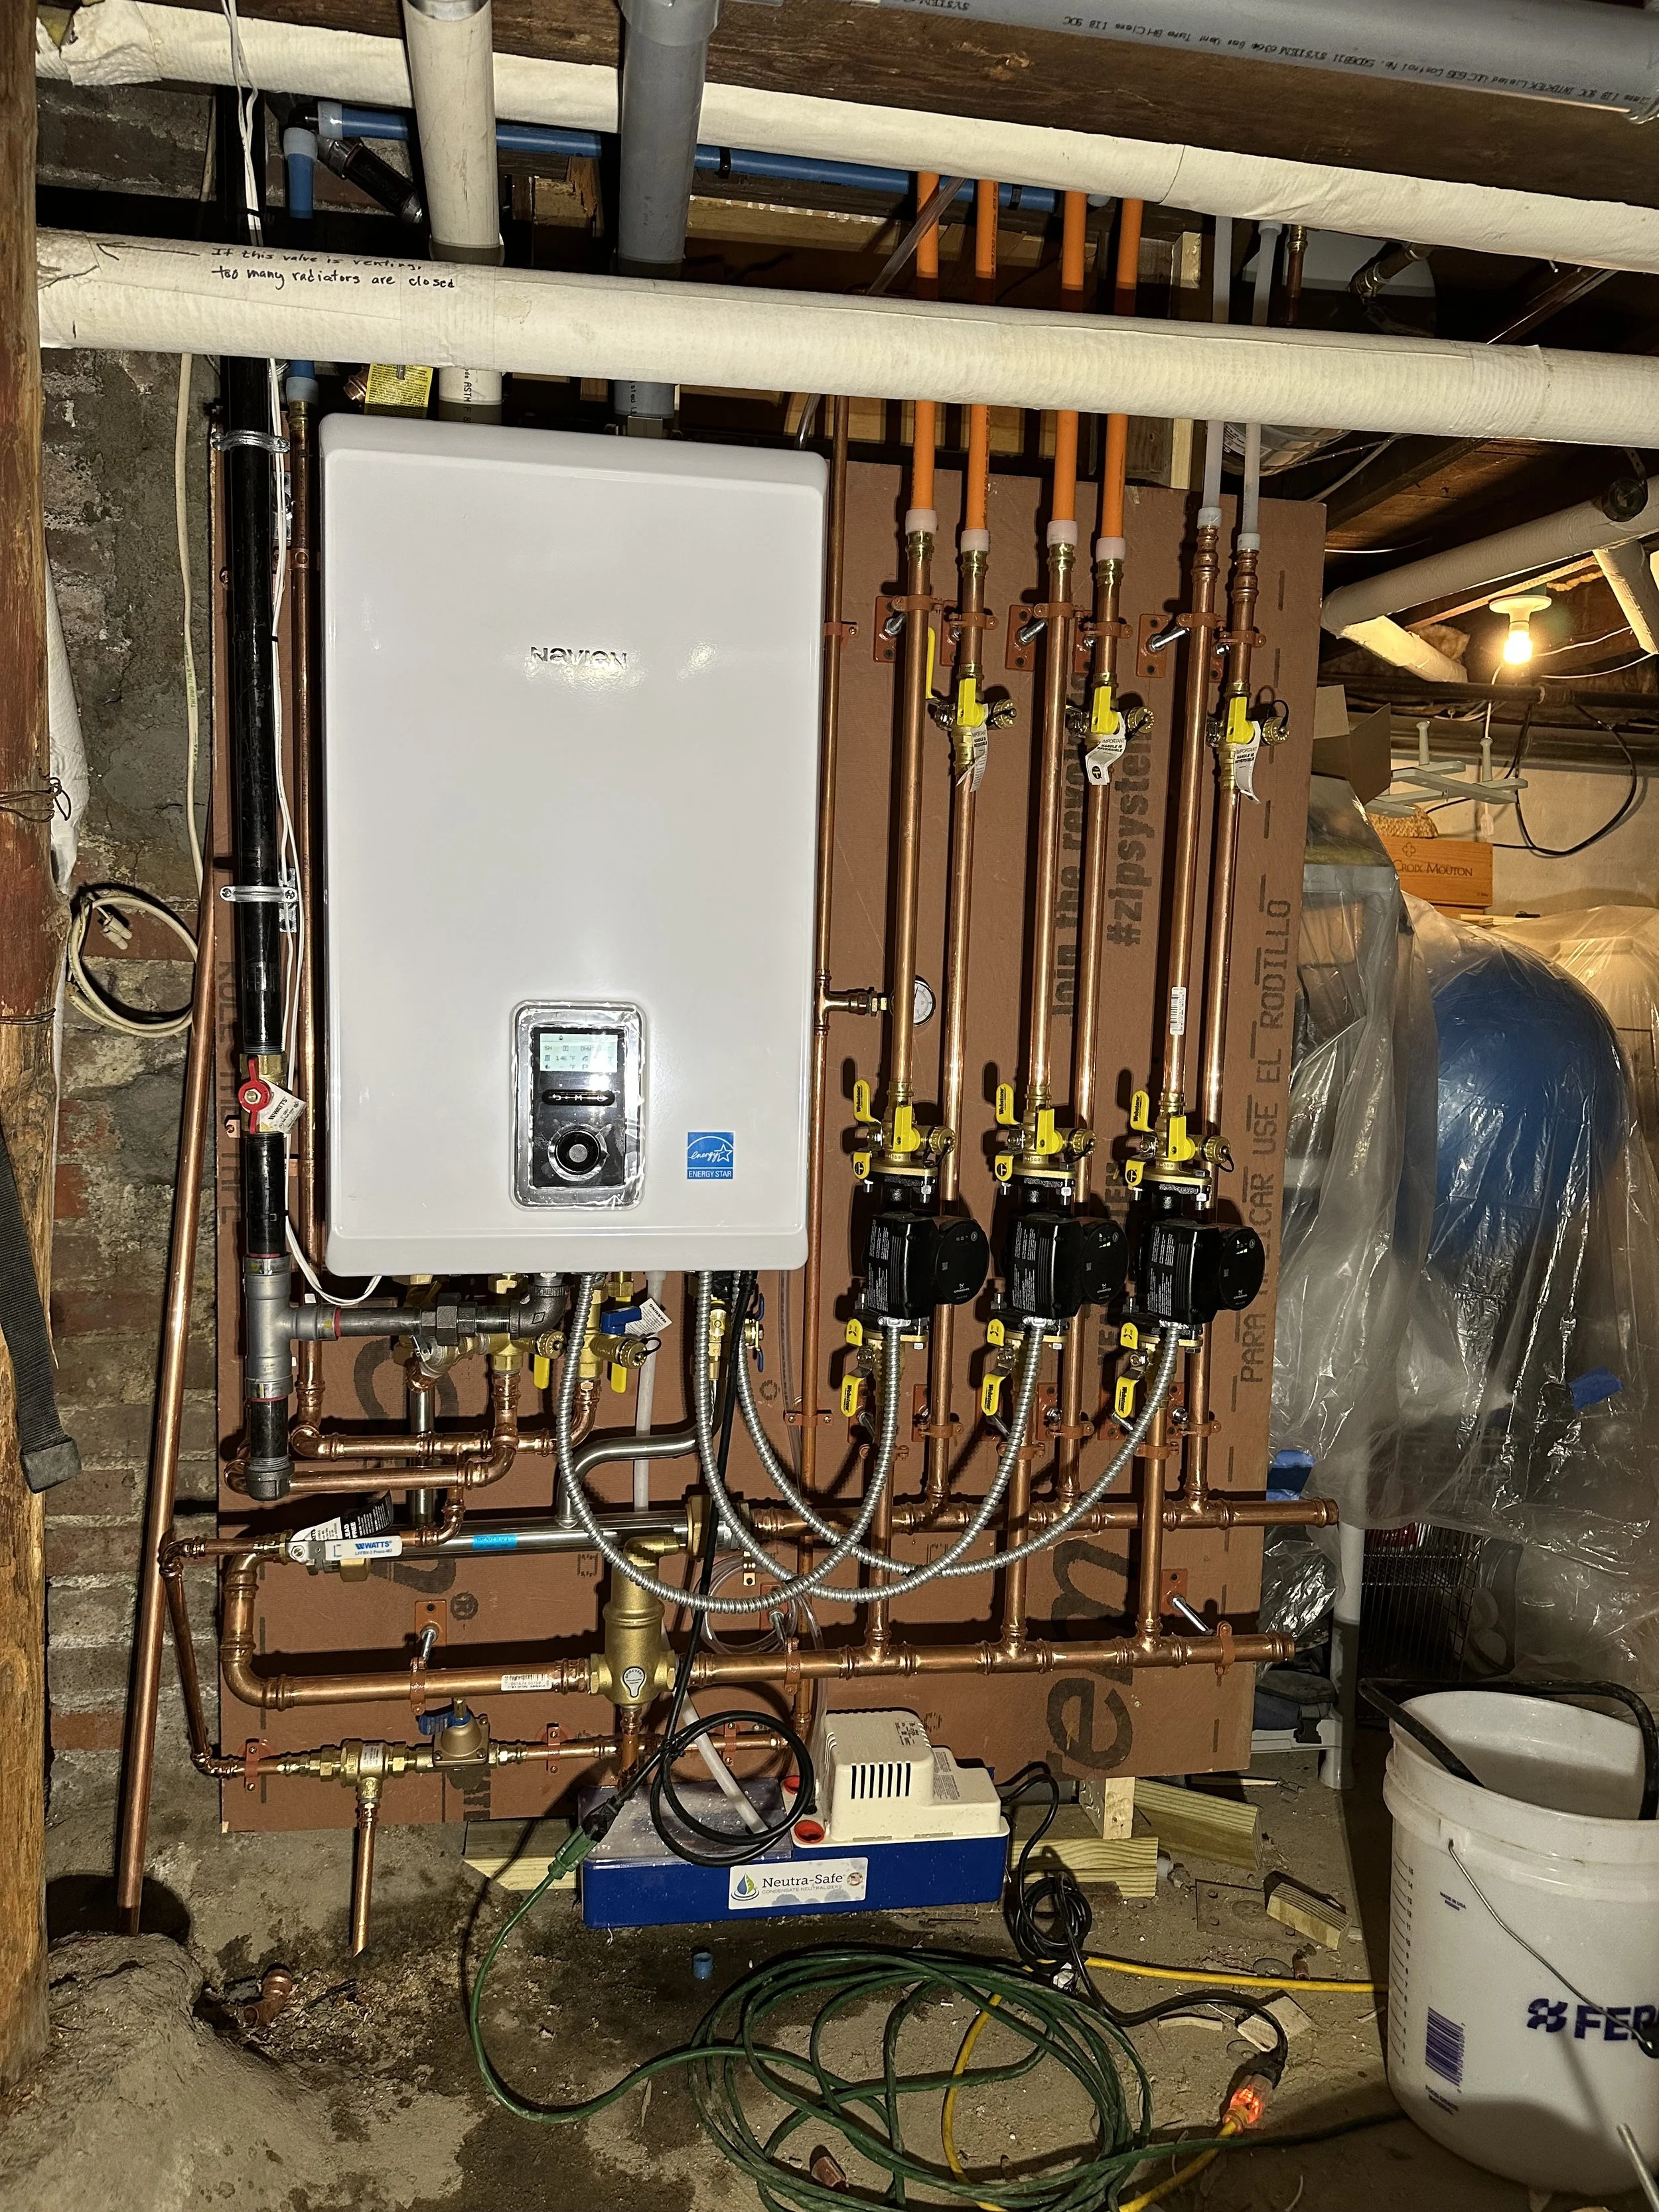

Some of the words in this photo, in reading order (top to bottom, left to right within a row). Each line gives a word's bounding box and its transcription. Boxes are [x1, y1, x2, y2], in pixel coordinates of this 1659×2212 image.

[1279, 45, 1328, 61] SYSTEM
[1401, 62, 1445, 78] Control
[212, 248, 233, 257] If
[242, 250, 273, 259] this
[283, 254, 318, 263] valve
[248, 268, 285, 290] many
[292, 269, 360, 284] radiators
[372, 275, 396, 285] are
[408, 275, 455, 289] closed
[1427, 863, 1473, 876] MOUTON
[1260, 899, 1291, 1030] RODILLO
[1256, 1048, 1281, 1084] EL
[1253, 1102, 1278, 1155] USE
[648, 1303, 667, 1323] WARNING
[1240, 1313, 1266, 1382] PARA
[359, 1540, 390, 1549] WATTS
[762, 1873, 843, 1888] Neutra-Safe
